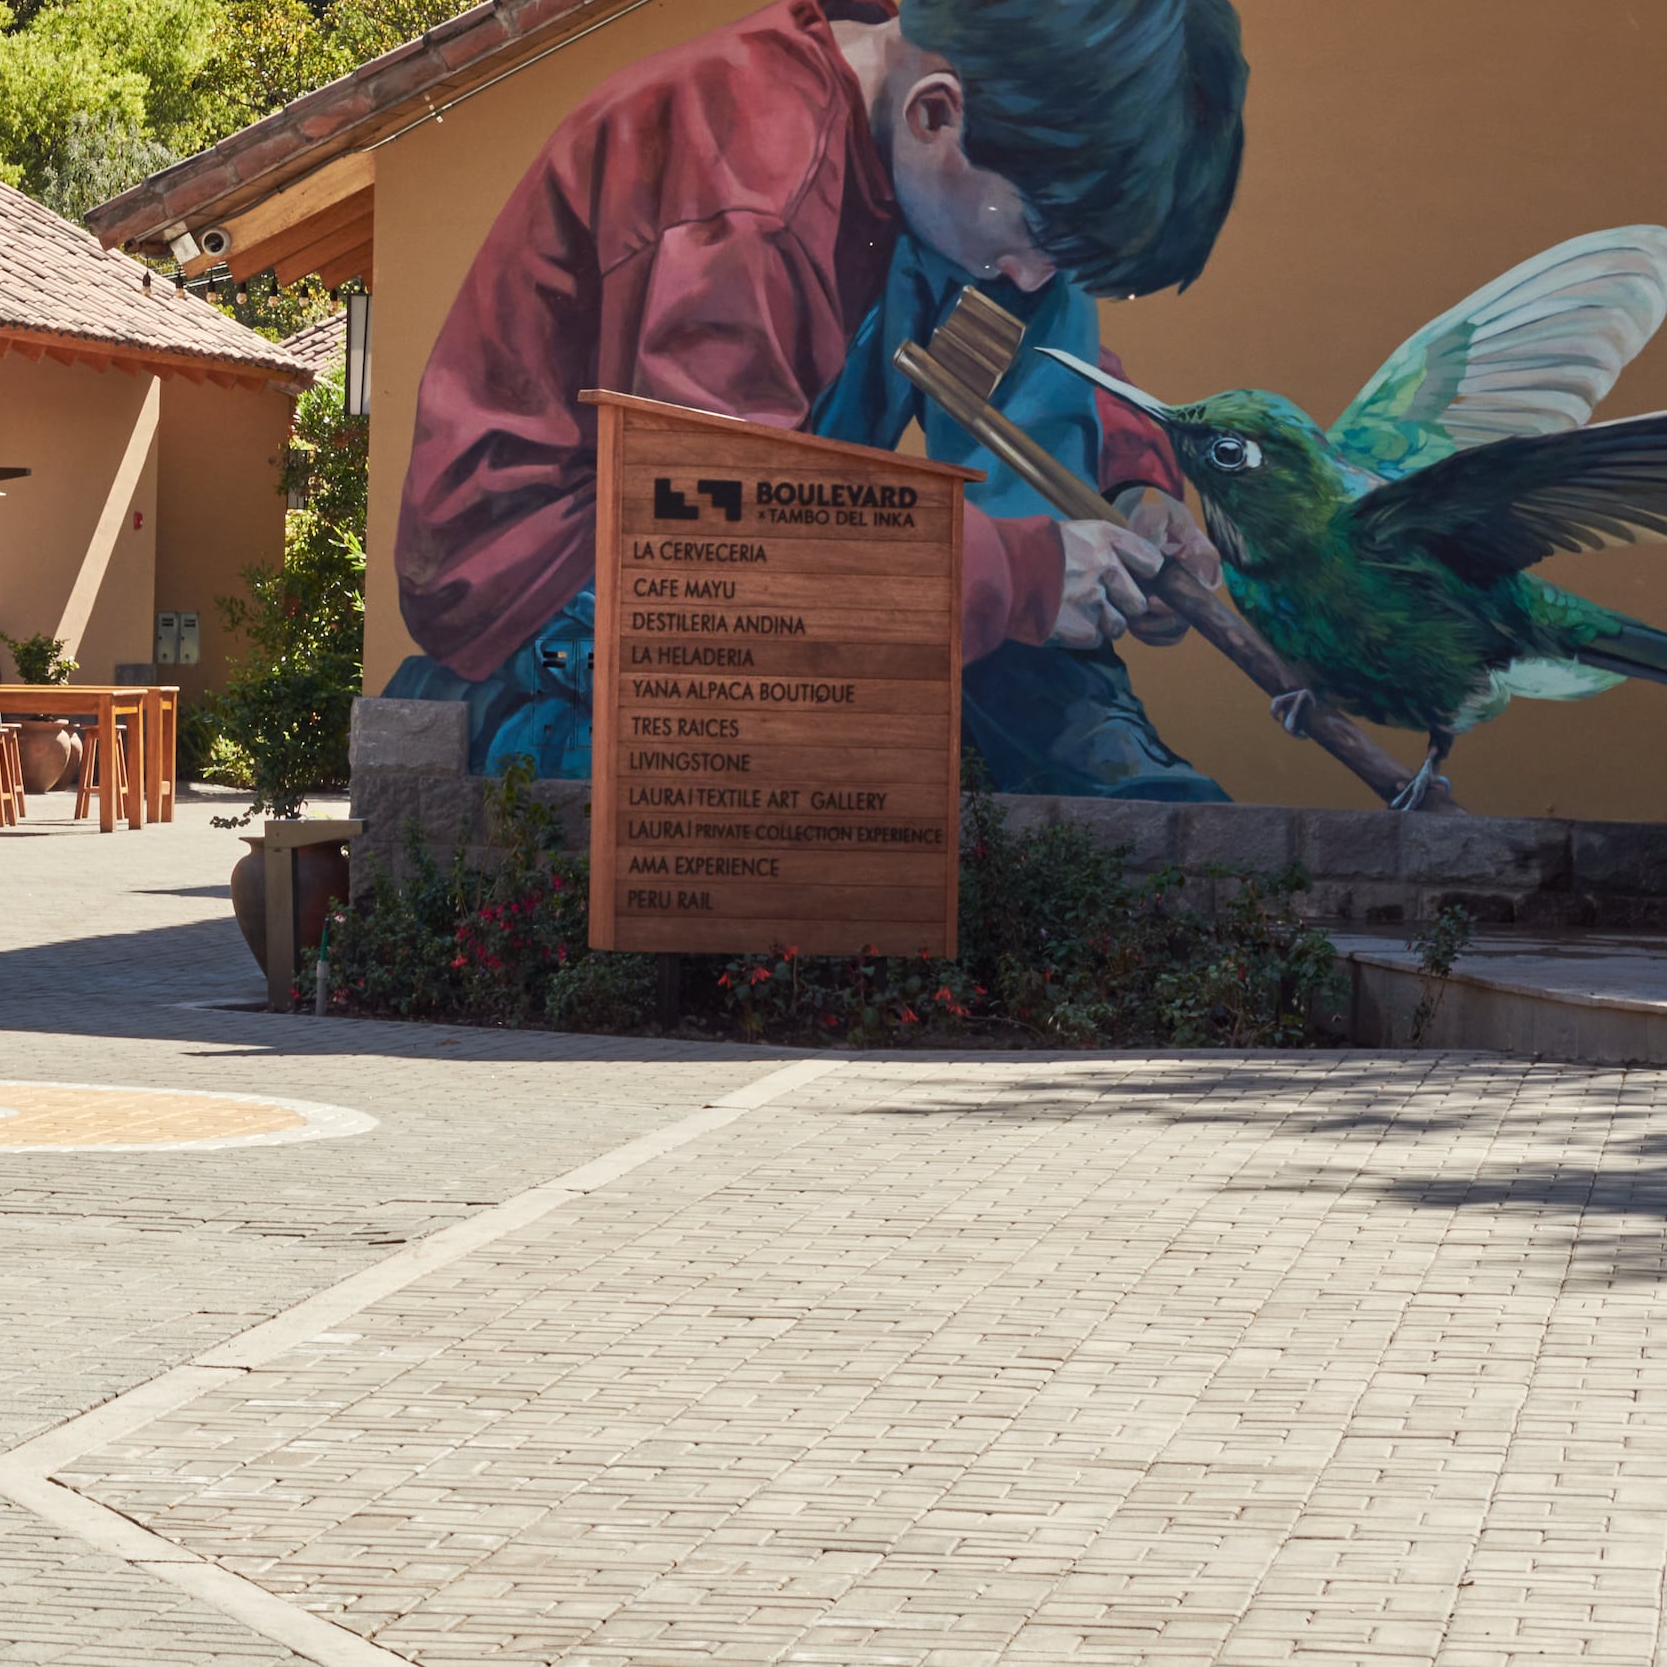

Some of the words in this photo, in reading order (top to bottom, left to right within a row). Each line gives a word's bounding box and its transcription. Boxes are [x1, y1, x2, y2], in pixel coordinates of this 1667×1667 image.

[756, 482, 918, 509] BOULEVARD
[769, 508, 830, 525] TAMBO
[835, 511, 867, 526] DEL
[873, 511, 916, 528] INKA
[633, 541, 655, 560] LA
[660, 541, 768, 563] CERVECERIA
[634, 578, 679, 598] CAFE
[684, 579, 736, 599] MAYU
[632, 612, 729, 633] DESTILERIA
[733, 614, 806, 634] ANDINA
[631, 645, 653, 665] LA
[658, 646, 755, 667] HELADERIA
[633, 679, 682, 698] YANA
[685, 680, 755, 701] ALPACA
[759, 682, 856, 703] BOUTIQUE
[632, 716, 673, 736] TRES
[678, 718, 740, 738] RAICES
[629, 751, 751, 772] LIVINGSTONE
[628, 787, 686, 807] LAURA
[696, 788, 762, 808] TEXTILE
[767, 790, 802, 809] ART
[810, 791, 888, 811] GALLERY
[628, 820, 685, 839] LAURA
[695, 823, 751, 841] PRIVATE
[755, 824, 853, 842] COLLECTION
[856, 826, 944, 845] EXPERIENCE
[628, 856, 669, 875] AMA
[674, 856, 780, 877] EXPERIENCE
[627, 889, 671, 910] PERU
[677, 890, 714, 911] RAIL
